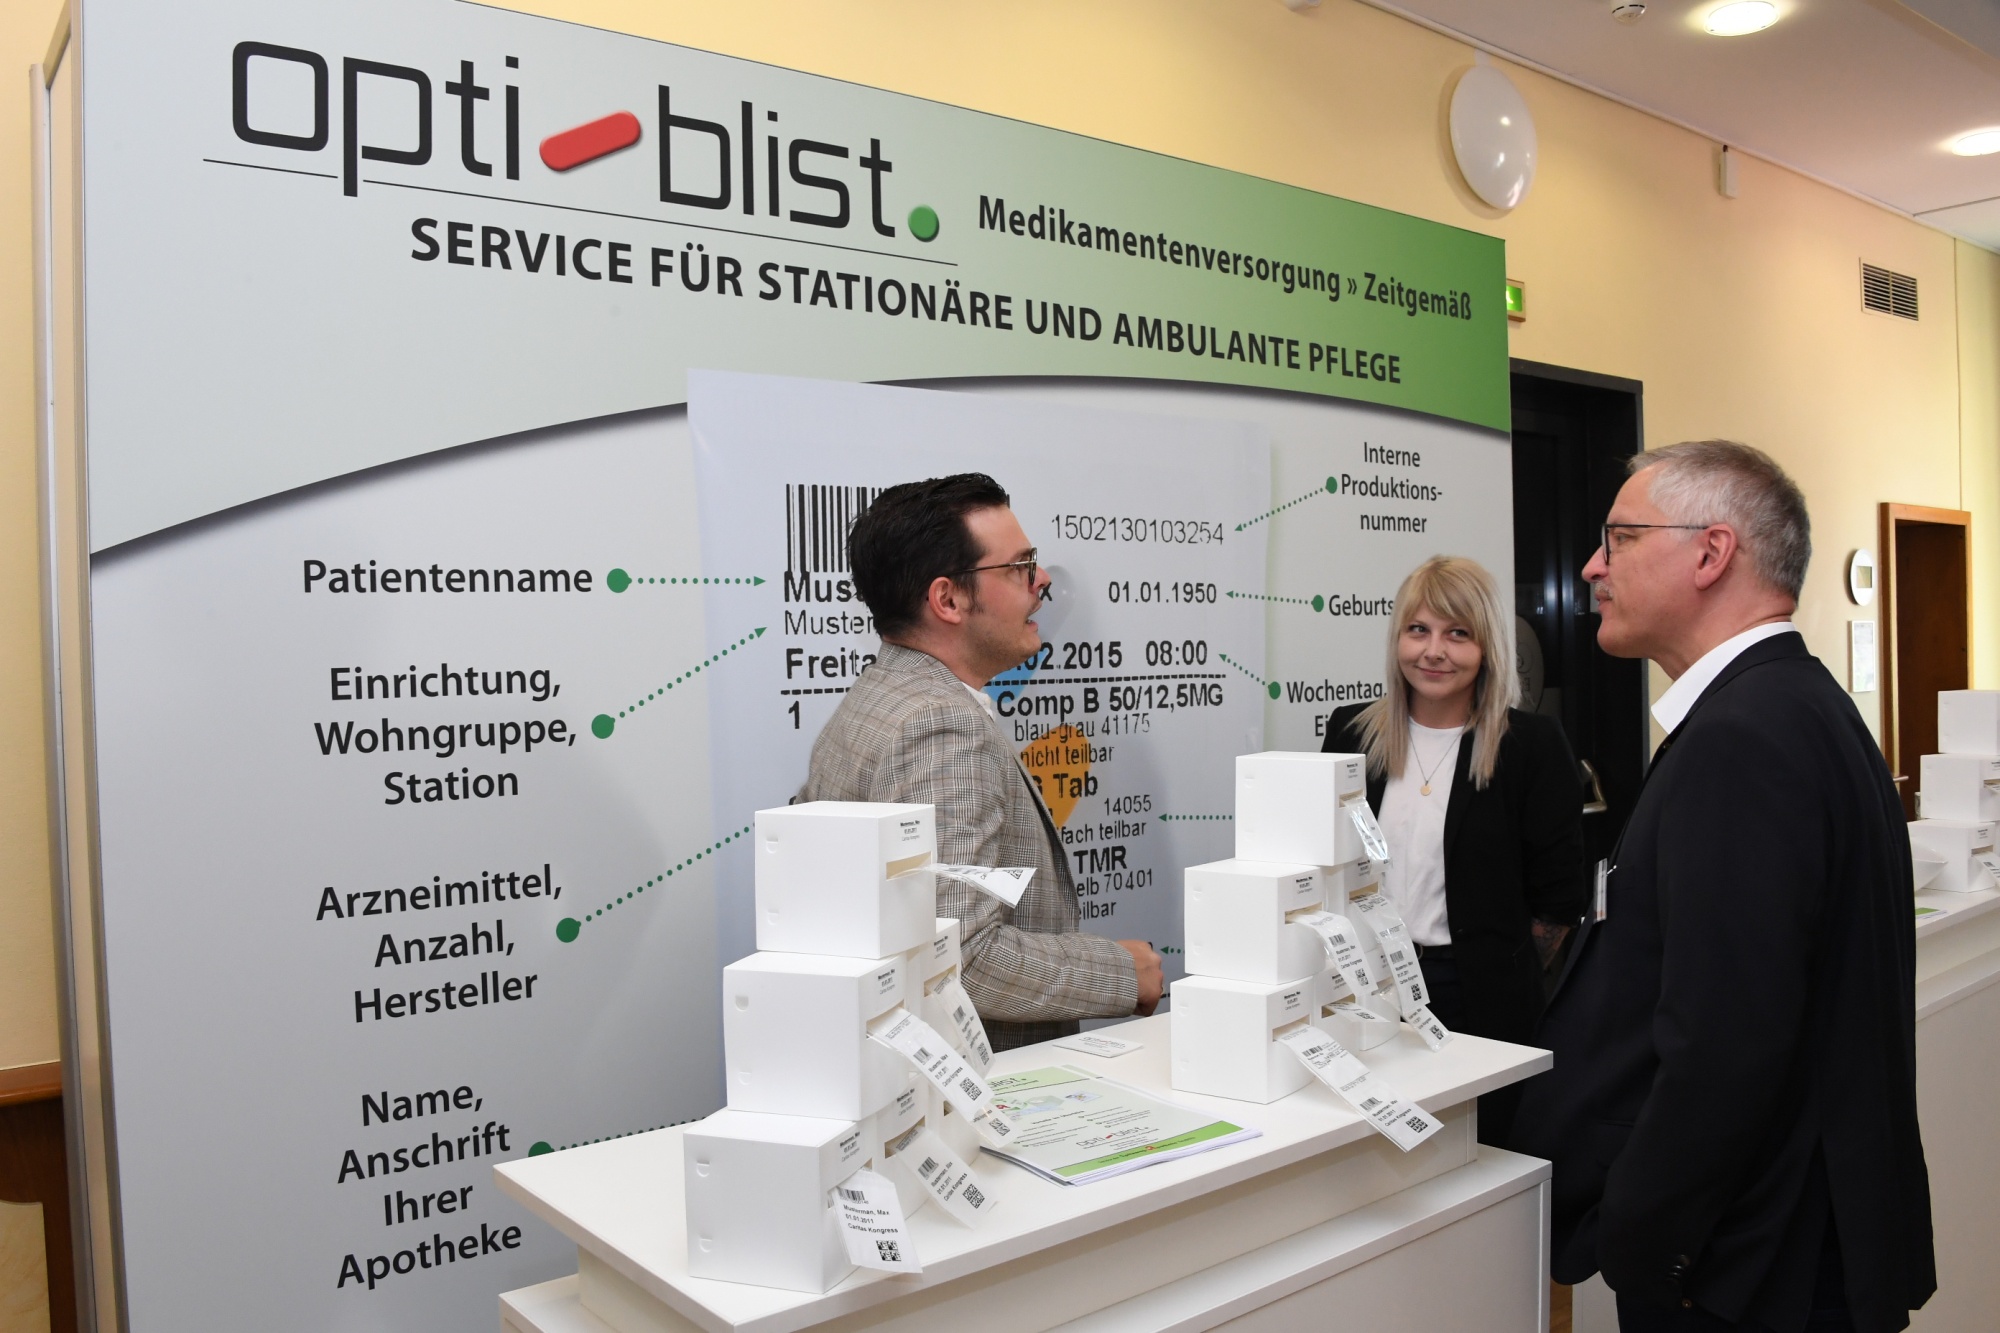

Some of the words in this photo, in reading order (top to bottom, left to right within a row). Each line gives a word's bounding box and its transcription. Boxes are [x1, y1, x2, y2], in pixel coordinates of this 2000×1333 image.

[232, 41, 520, 198] opti
[978, 195, 1341, 302] Medikamentenversorgung
[1364, 272, 1472, 321] Zeitgemäß
[411, 217, 633, 284] SERVICE
[651, 243, 743, 297] FÜR
[758, 262, 1014, 330] STATIONÄRE
[1025, 299, 1102, 341] UND
[1113, 313, 1301, 371] AMBULANTE
[1309, 343, 1401, 384] PFLEGE
[1363, 441, 1421, 467] Interne
[1341, 474, 1443, 502] Produktions-
[1051, 514, 1224, 545] 1502130103254
[1360, 513, 1428, 533] nummer
[303, 559, 593, 594] Patientenname
[1108, 580, 1217, 604] 01.01.1950
[1328, 594, 1394, 616] Geburts
[785, 610, 874, 635] Muster
[786, 647, 877, 679] Freita
[1145, 639, 1208, 667] 08:00
[330, 663, 561, 702] Einrichtung,
[788, 700, 801, 730] 1
[996, 691, 1075, 722] Comp
[1083, 687, 1100, 713] B
[1109, 683, 1223, 713] 50/12,5MG
[314, 718, 577, 759] Wohngruppe,
[1014, 719, 1095, 744] blau-grau
[1101, 713, 1150, 736] 41175
[1020, 745, 1060, 768] nicht
[1065, 743, 1115, 766] teilbar
[384, 767, 519, 806] Station
[1052, 771, 1098, 799] Tab
[1104, 794, 1152, 816] 14055
[1057, 823, 1093, 845] fach
[1099, 819, 1147, 841] teilbar
[1073, 845, 1128, 875] TMR
[316, 864, 562, 921] Arzneimittel,
[1076, 876, 1100, 898] elb
[1103, 868, 1152, 893] 70401
[374, 920, 515, 968] Anzahl,
[354, 970, 538, 1024] Hersteller
[361, 1085, 483, 1127] Name,
[337, 1121, 511, 1184] Anschrift
[384, 1185, 474, 1227] Ihrer
[336, 1223, 522, 1290] Apotheke
